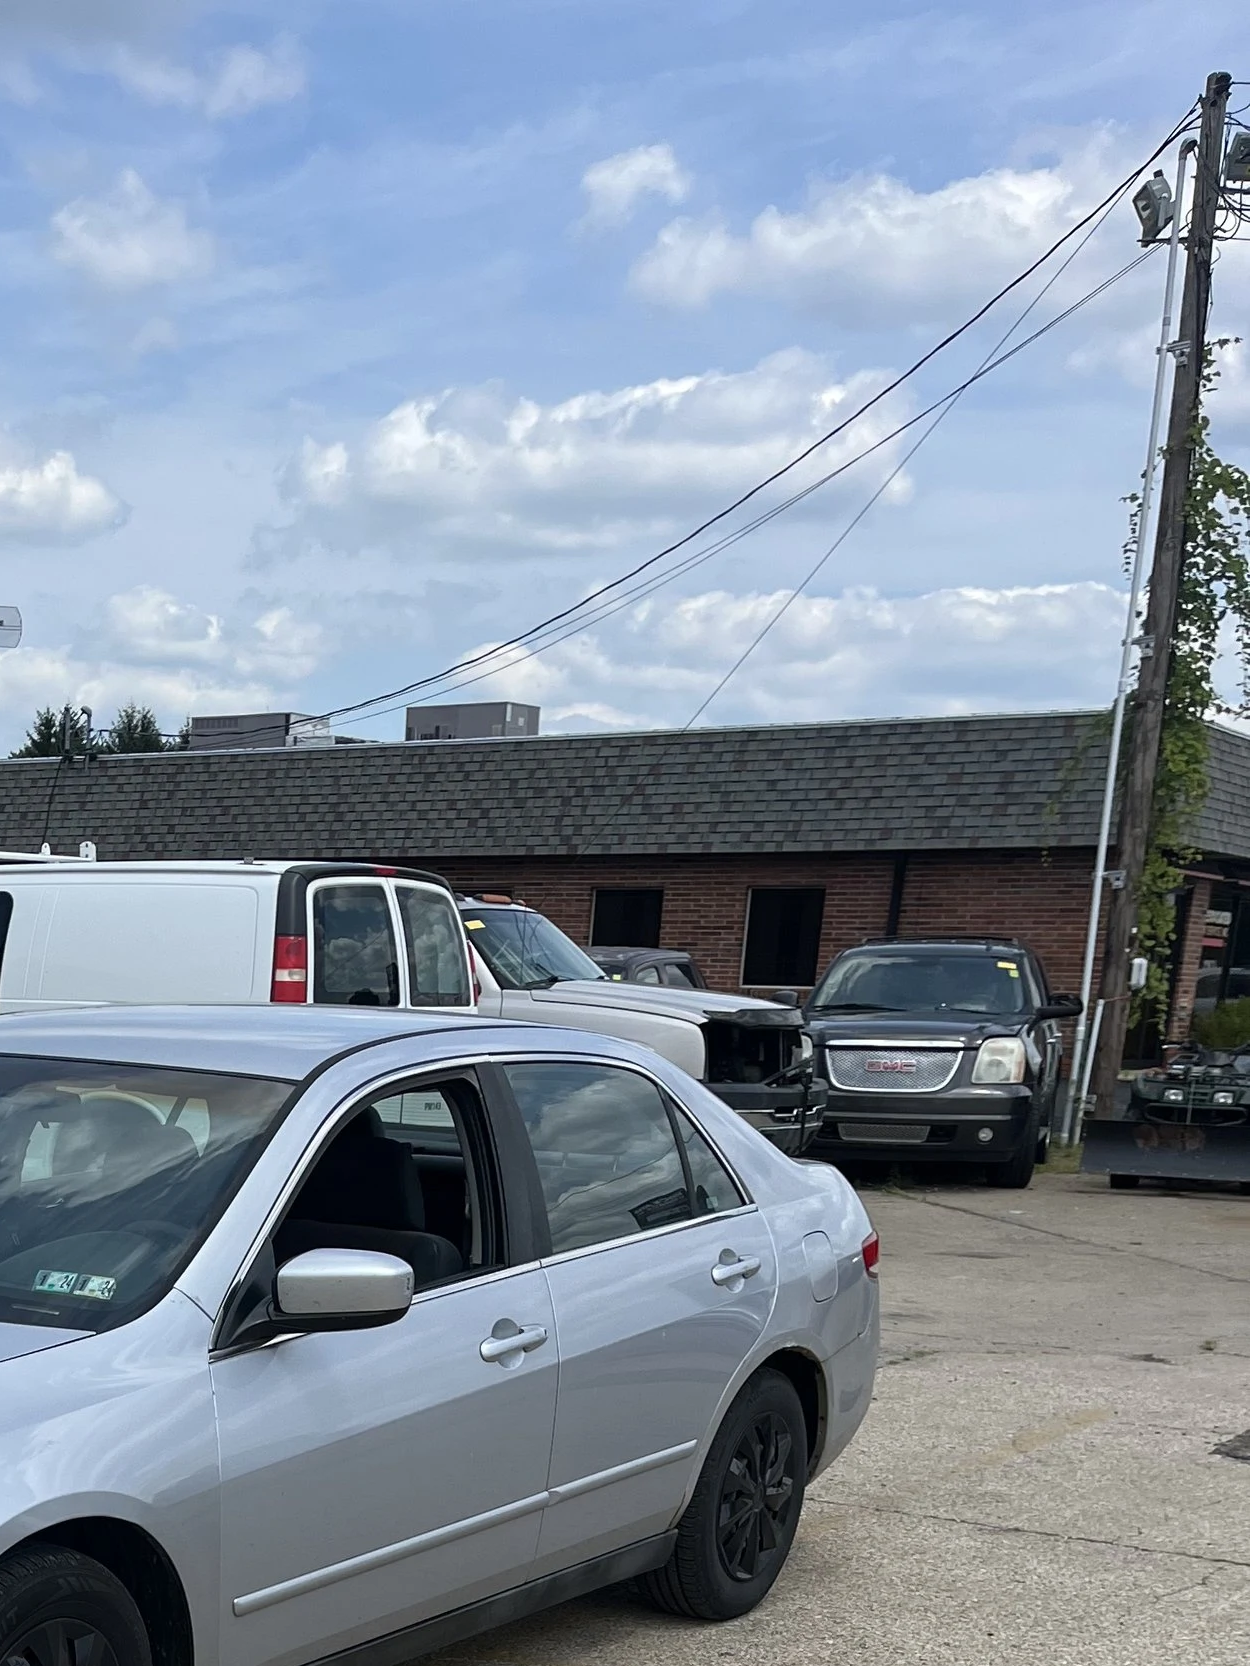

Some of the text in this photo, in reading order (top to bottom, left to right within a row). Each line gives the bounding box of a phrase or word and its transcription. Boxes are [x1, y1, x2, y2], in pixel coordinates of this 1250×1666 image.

[866, 1060, 916, 1072] GMC
[59, 1274, 75, 1289] 24
[100, 1280, 116, 1297] 24
